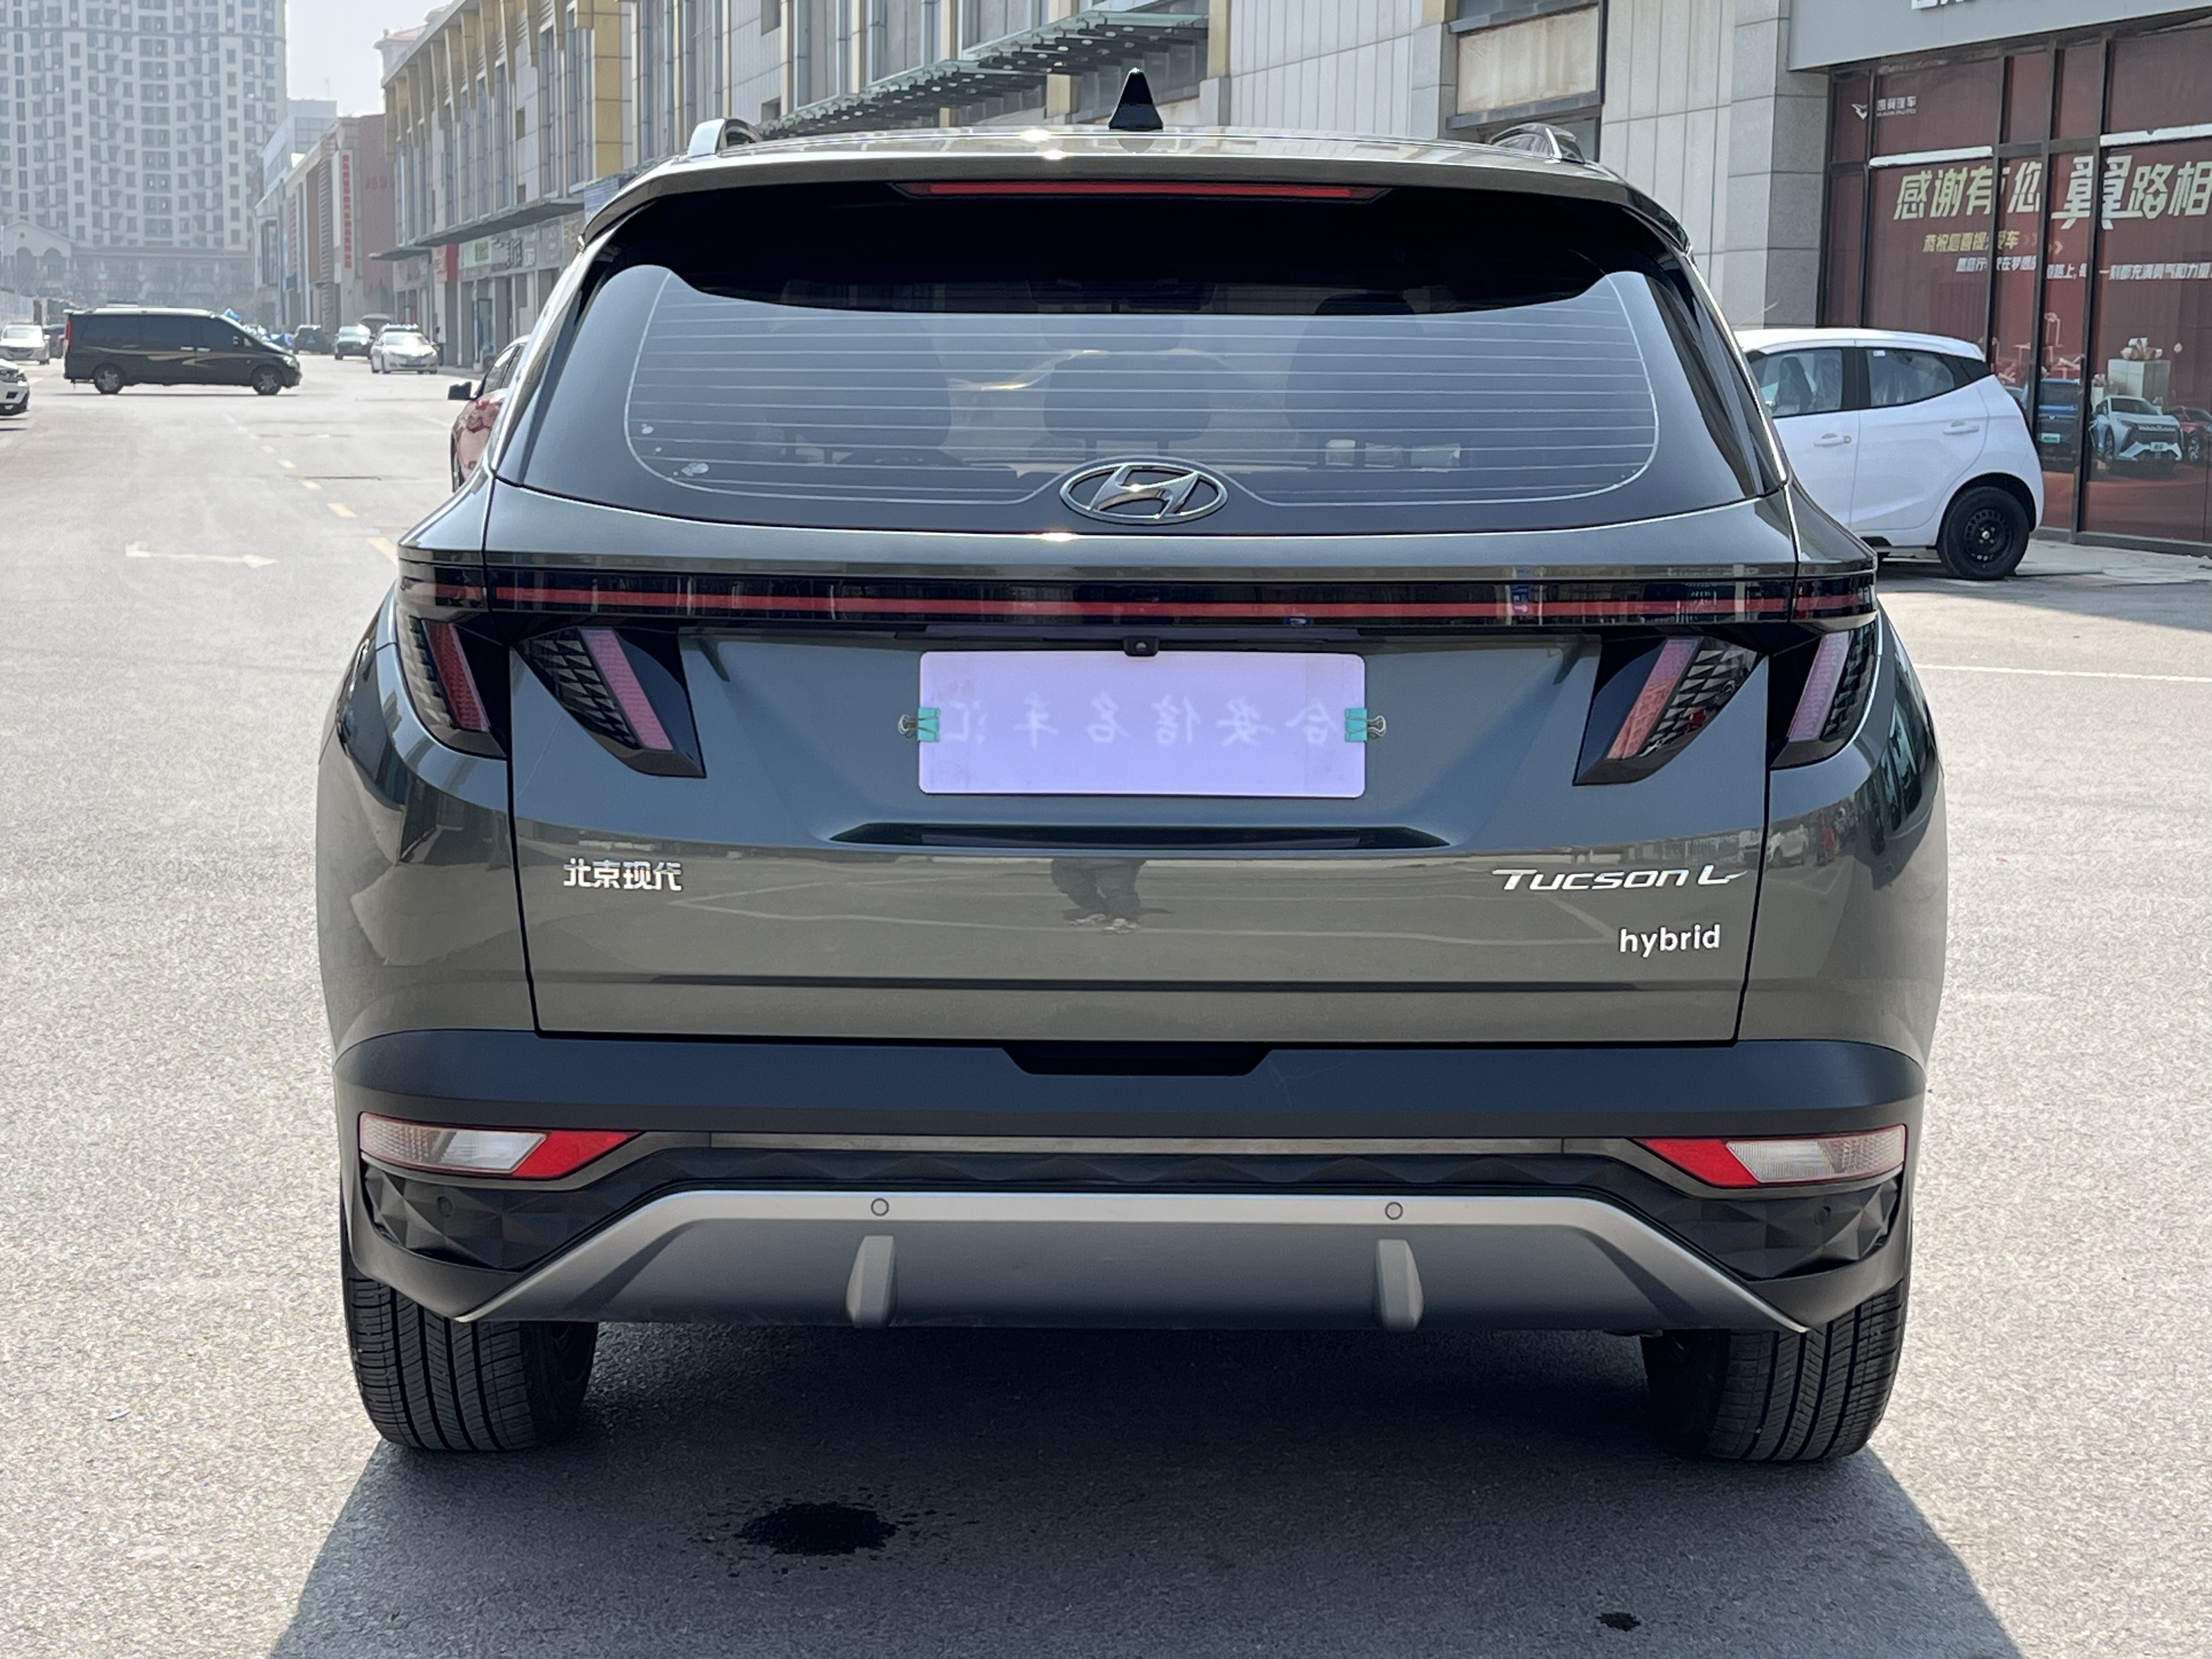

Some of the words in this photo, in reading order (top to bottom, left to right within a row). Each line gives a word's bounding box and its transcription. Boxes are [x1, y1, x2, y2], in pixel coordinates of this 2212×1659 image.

[563, 857, 682, 891] 北京现代
[1697, 864, 1748, 885] L
[1618, 924, 1721, 958] hybrid
